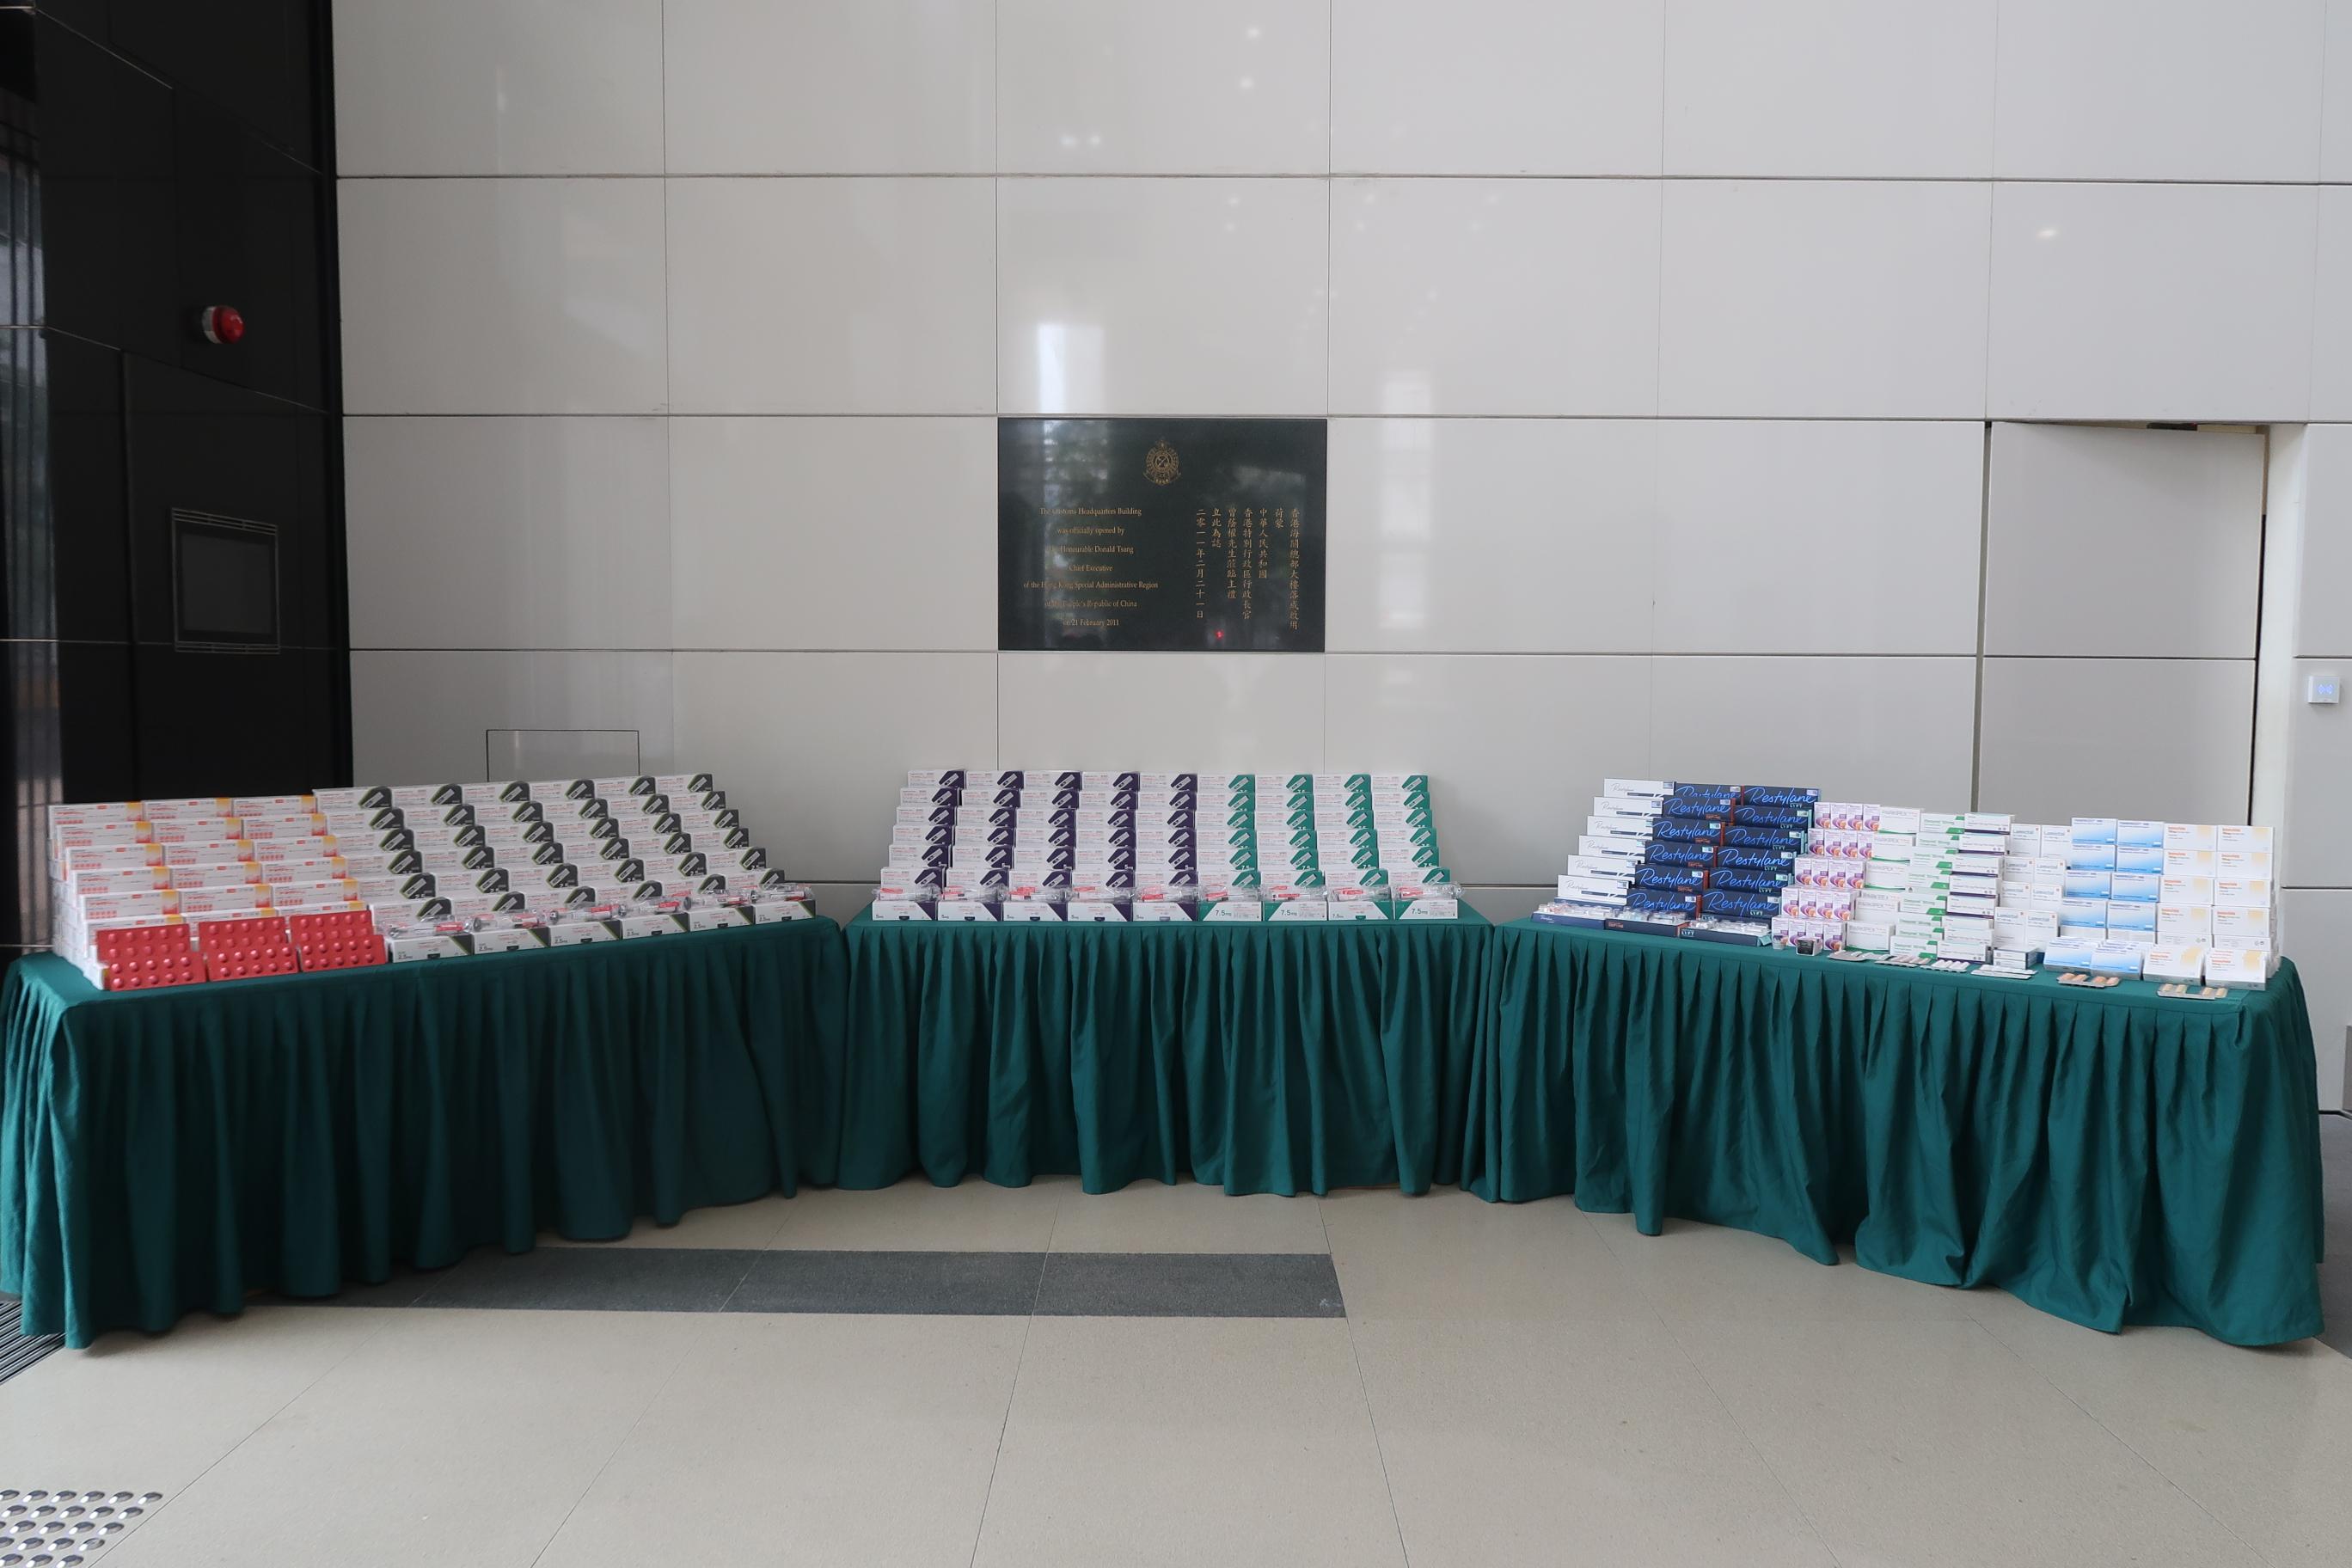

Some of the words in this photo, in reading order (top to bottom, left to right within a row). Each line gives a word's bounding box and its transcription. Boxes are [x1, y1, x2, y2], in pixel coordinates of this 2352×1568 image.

[1078, 506, 1116, 517] Headquarters
[1118, 506, 1142, 517] Building
[1069, 526, 1093, 536] officially
[1095, 527, 1116, 536] opened
[1117, 527, 1124, 536] by
[1061, 545, 1093, 554] Honourable
[1094, 545, 1116, 554] Donald
[1117, 545, 1134, 555] Tsang
[1259, 507, 1269, 579] 中華人民共和國
[1196, 509, 1206, 618] 二零一一年二月二十一日
[1242, 507, 1253, 620] 香港特別行政區行政長官
[1075, 580, 1094, 591] Special
[1095, 580, 1138, 589] Administrative
[1138, 581, 1159, 590] Region
[1087, 599, 1112, 609] Republic
[1080, 618, 1105, 628] February
[1743, 787, 1816, 806] Restylane
[1663, 798, 1730, 817] Restylane
[1735, 807, 1806, 825] Restylane
[1652, 821, 1720, 841] Restylane
[1725, 828, 1799, 848] Restylane
[1645, 844, 1714, 866] Restylane
[1718, 848, 1791, 870] Restylane
[1635, 868, 1704, 887] Restylane
[1710, 870, 1787, 891] Restylane
[1702, 891, 1778, 916] Restylane
